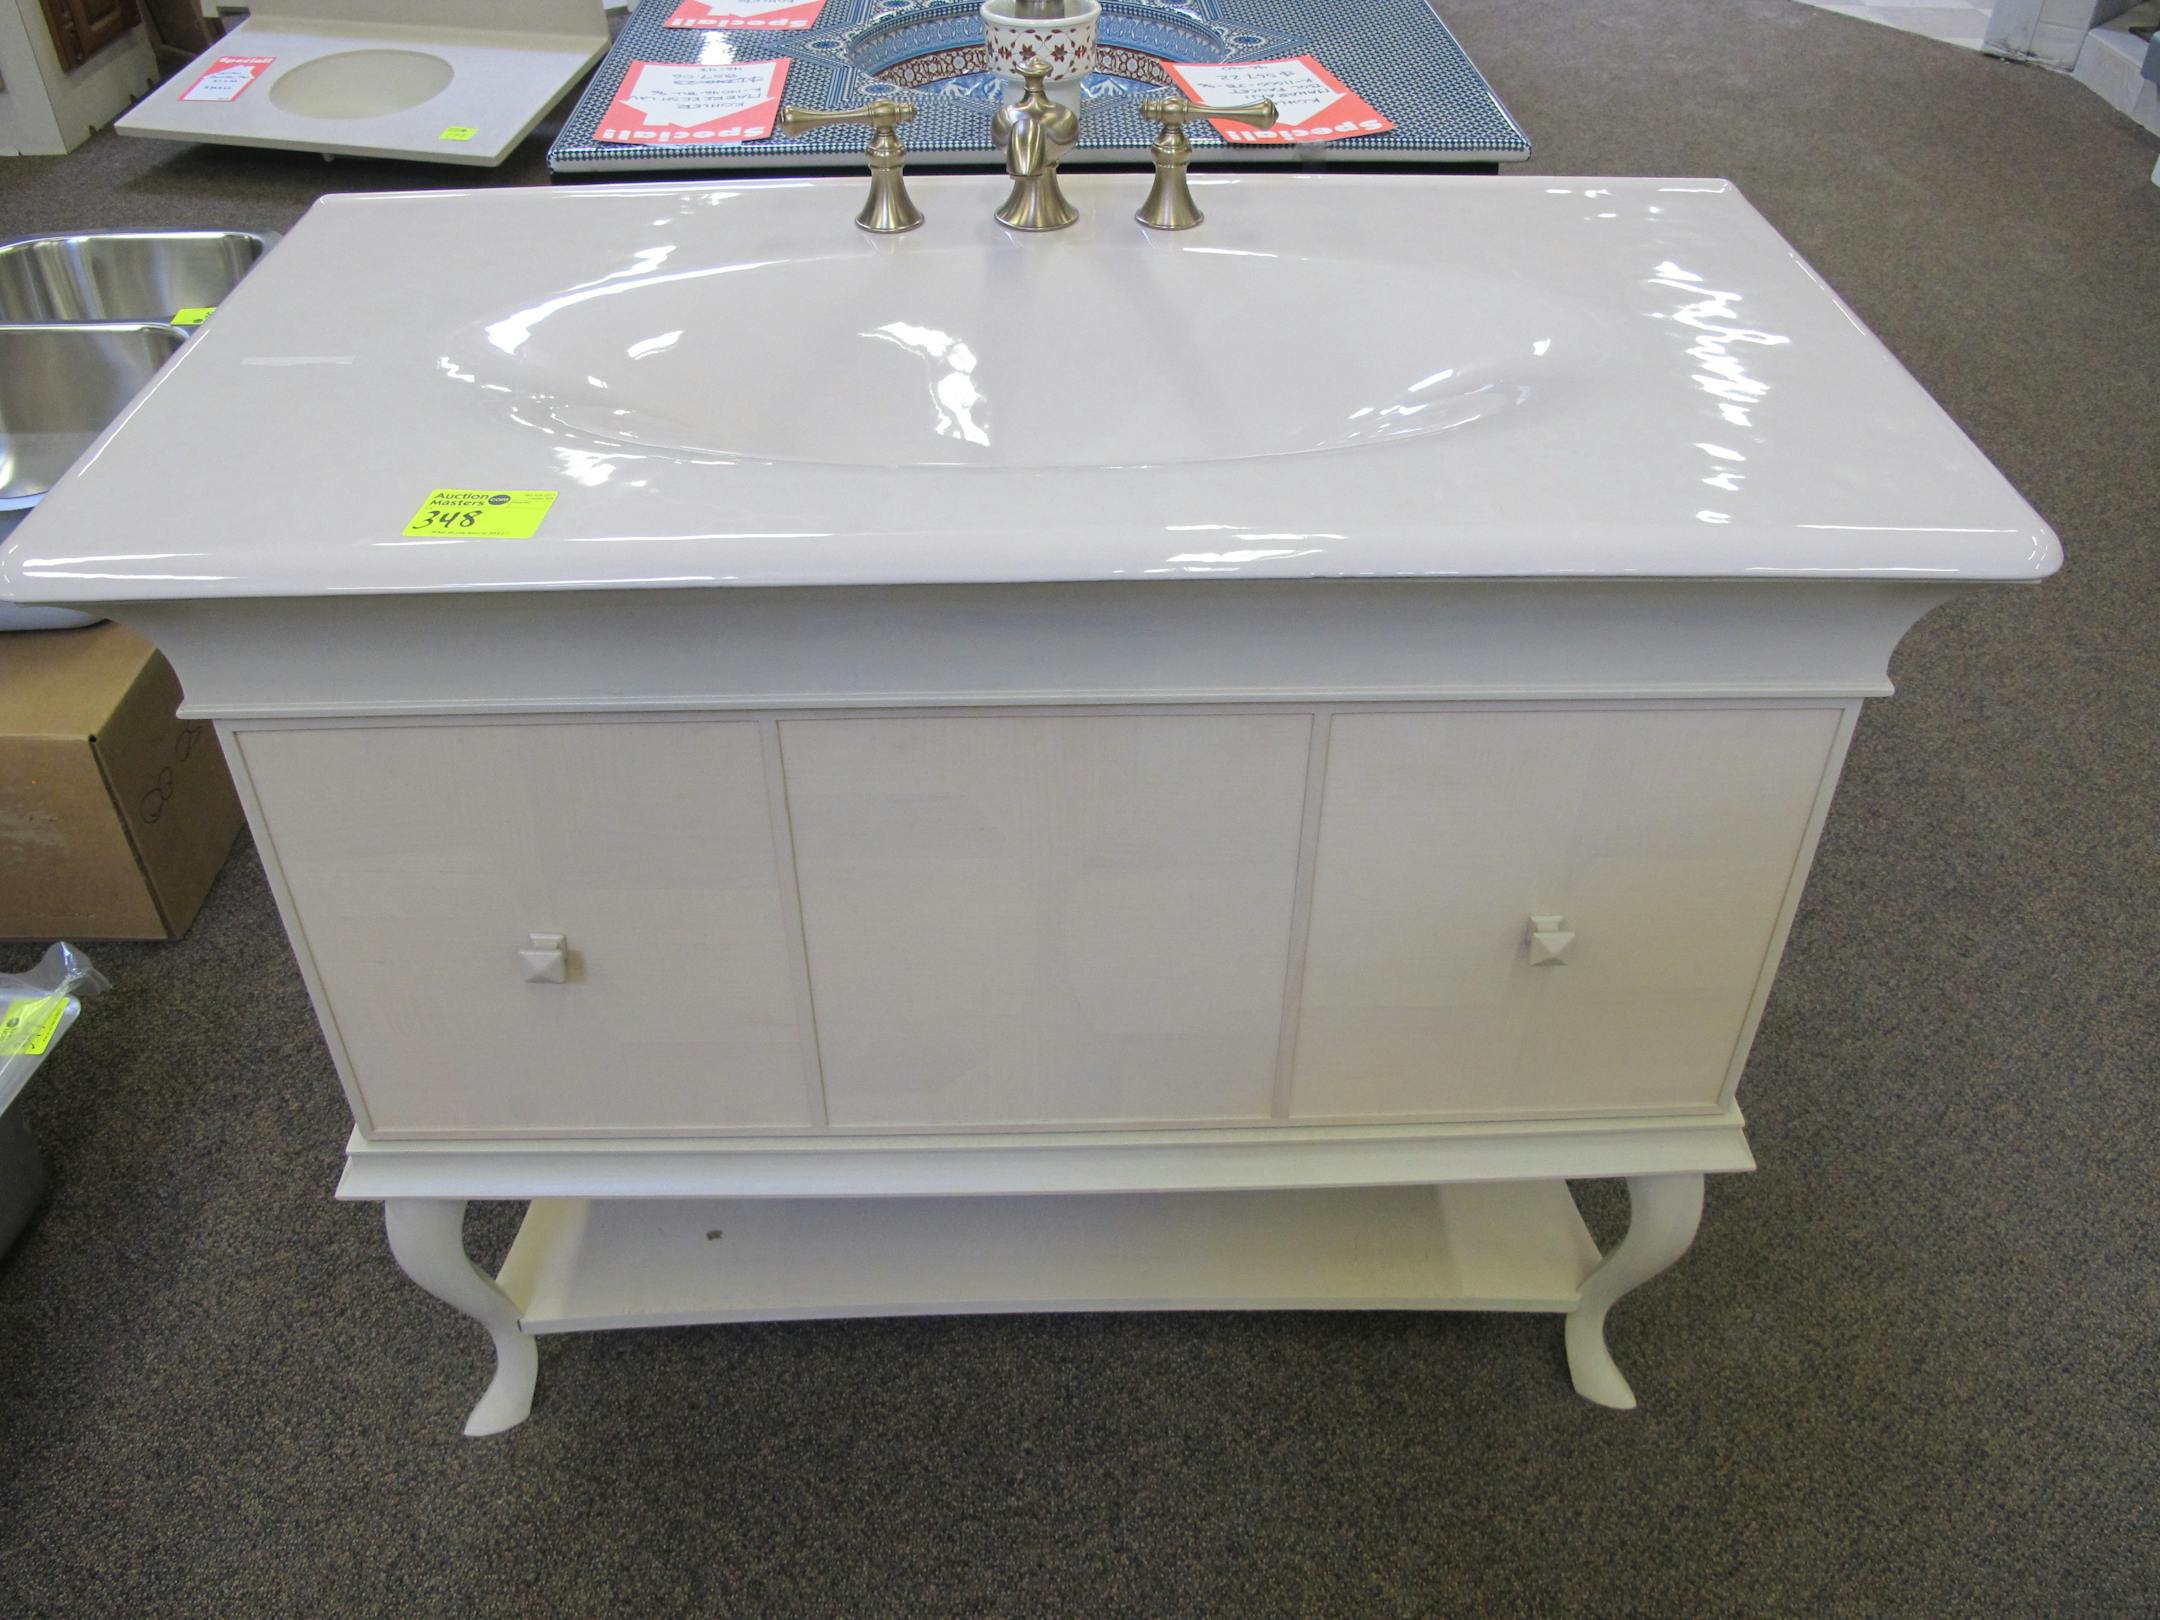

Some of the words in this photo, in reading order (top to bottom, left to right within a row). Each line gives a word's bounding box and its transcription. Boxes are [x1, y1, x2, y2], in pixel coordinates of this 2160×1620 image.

[671, 17, 809, 28] Special!
[603, 128, 764, 142] Special!
[1225, 119, 1383, 141] Special!
[433, 492, 490, 501] Auction
[429, 500, 486, 508] Masters
[412, 510, 483, 530] 348
